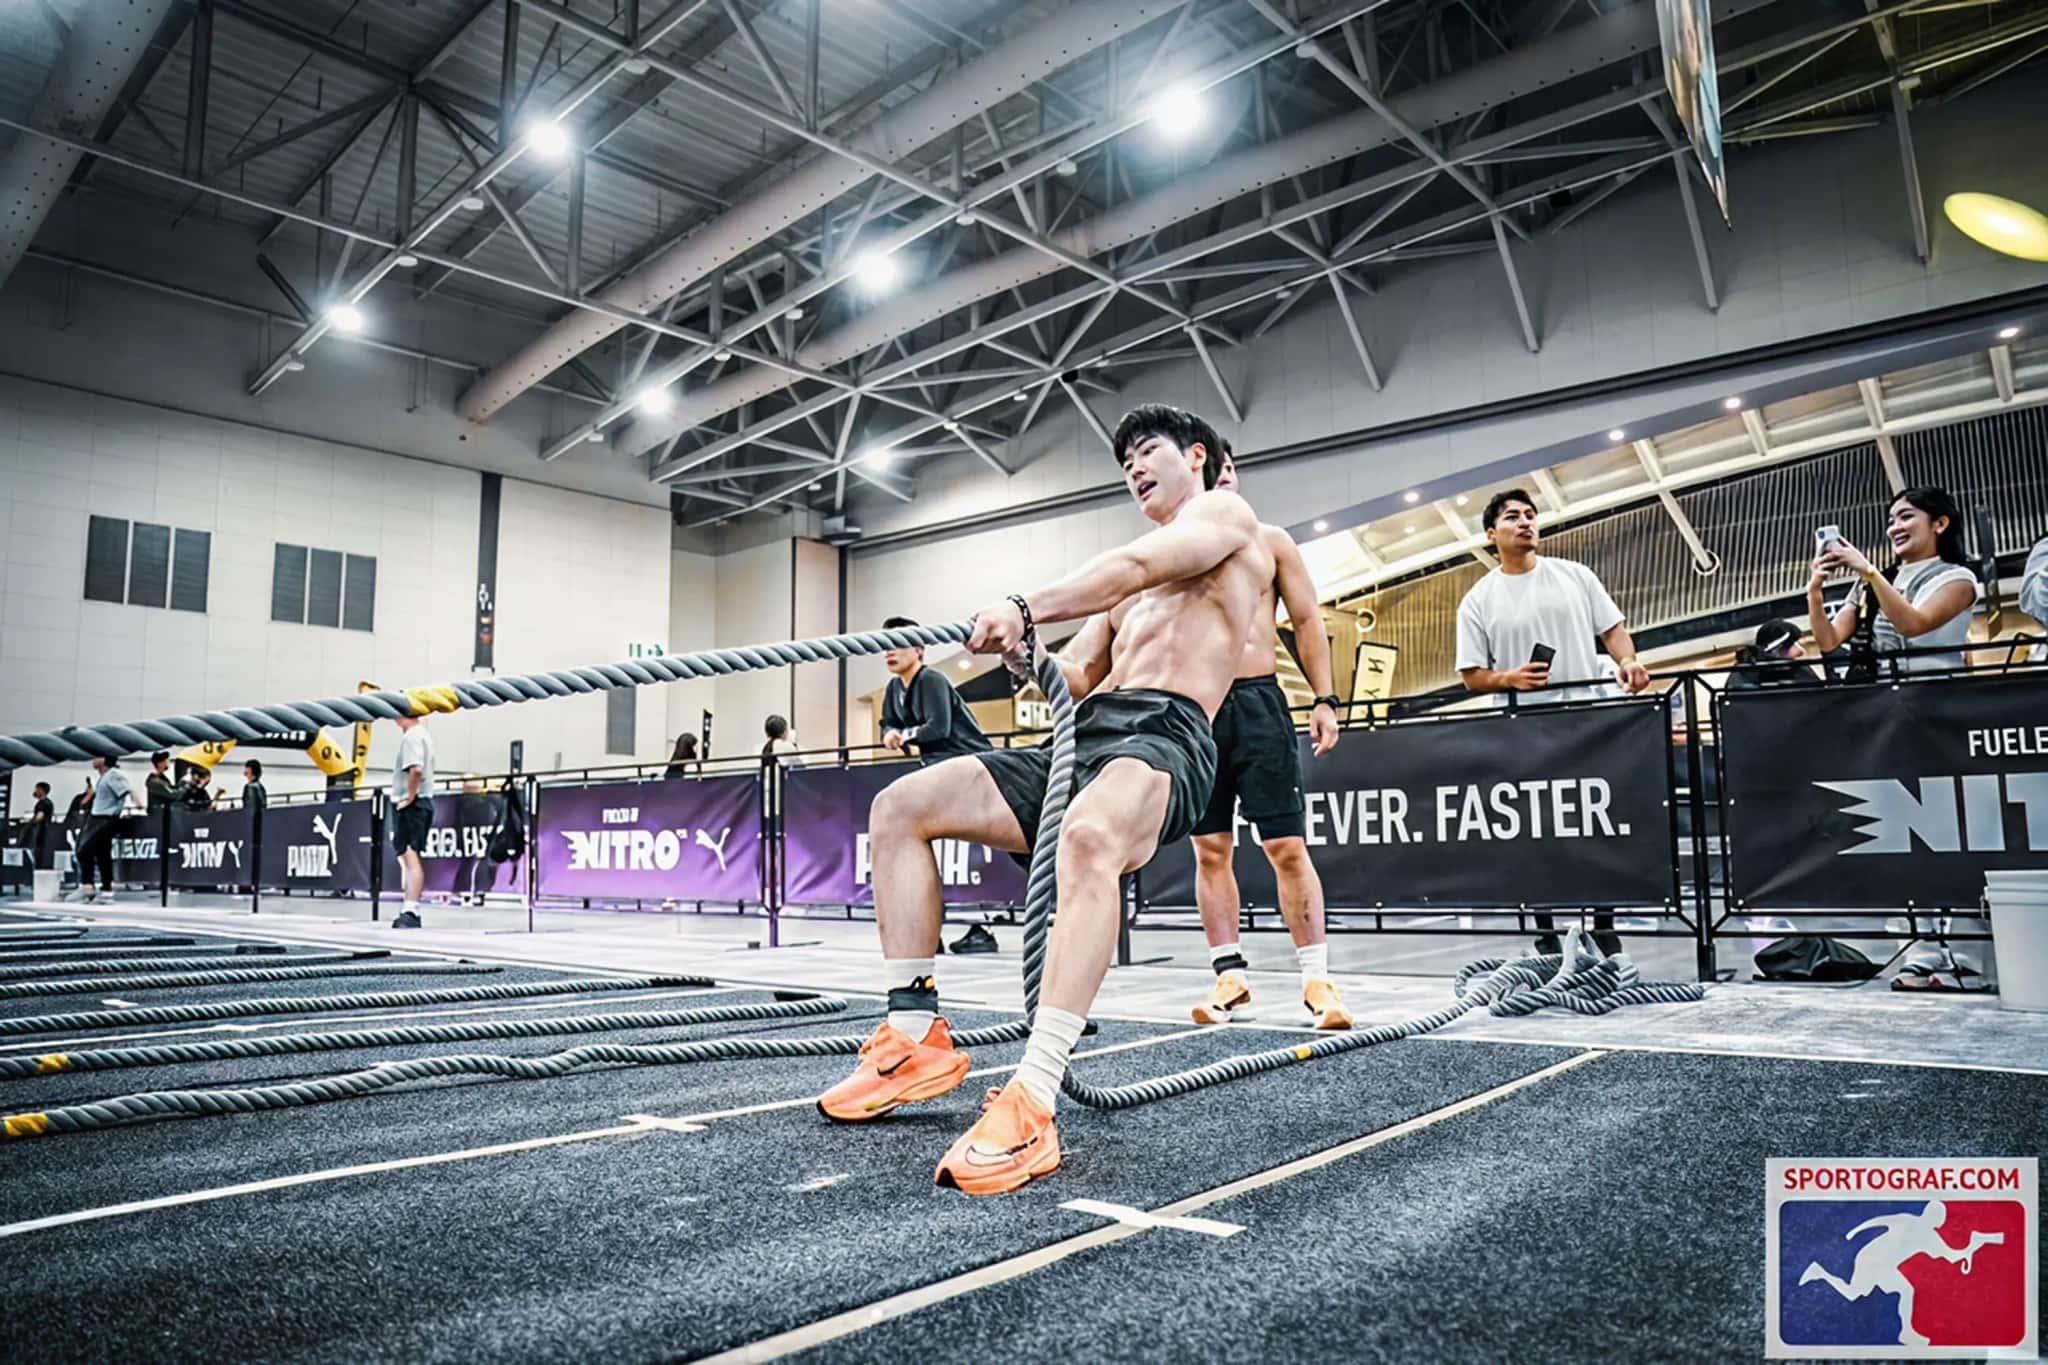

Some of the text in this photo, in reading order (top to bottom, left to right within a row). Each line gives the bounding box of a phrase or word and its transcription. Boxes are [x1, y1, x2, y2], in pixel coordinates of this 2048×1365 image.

[1968, 726, 2048, 757] FUELE
[1434, 777, 1631, 842] FASTER.
[560, 829, 681, 871] NITRO
